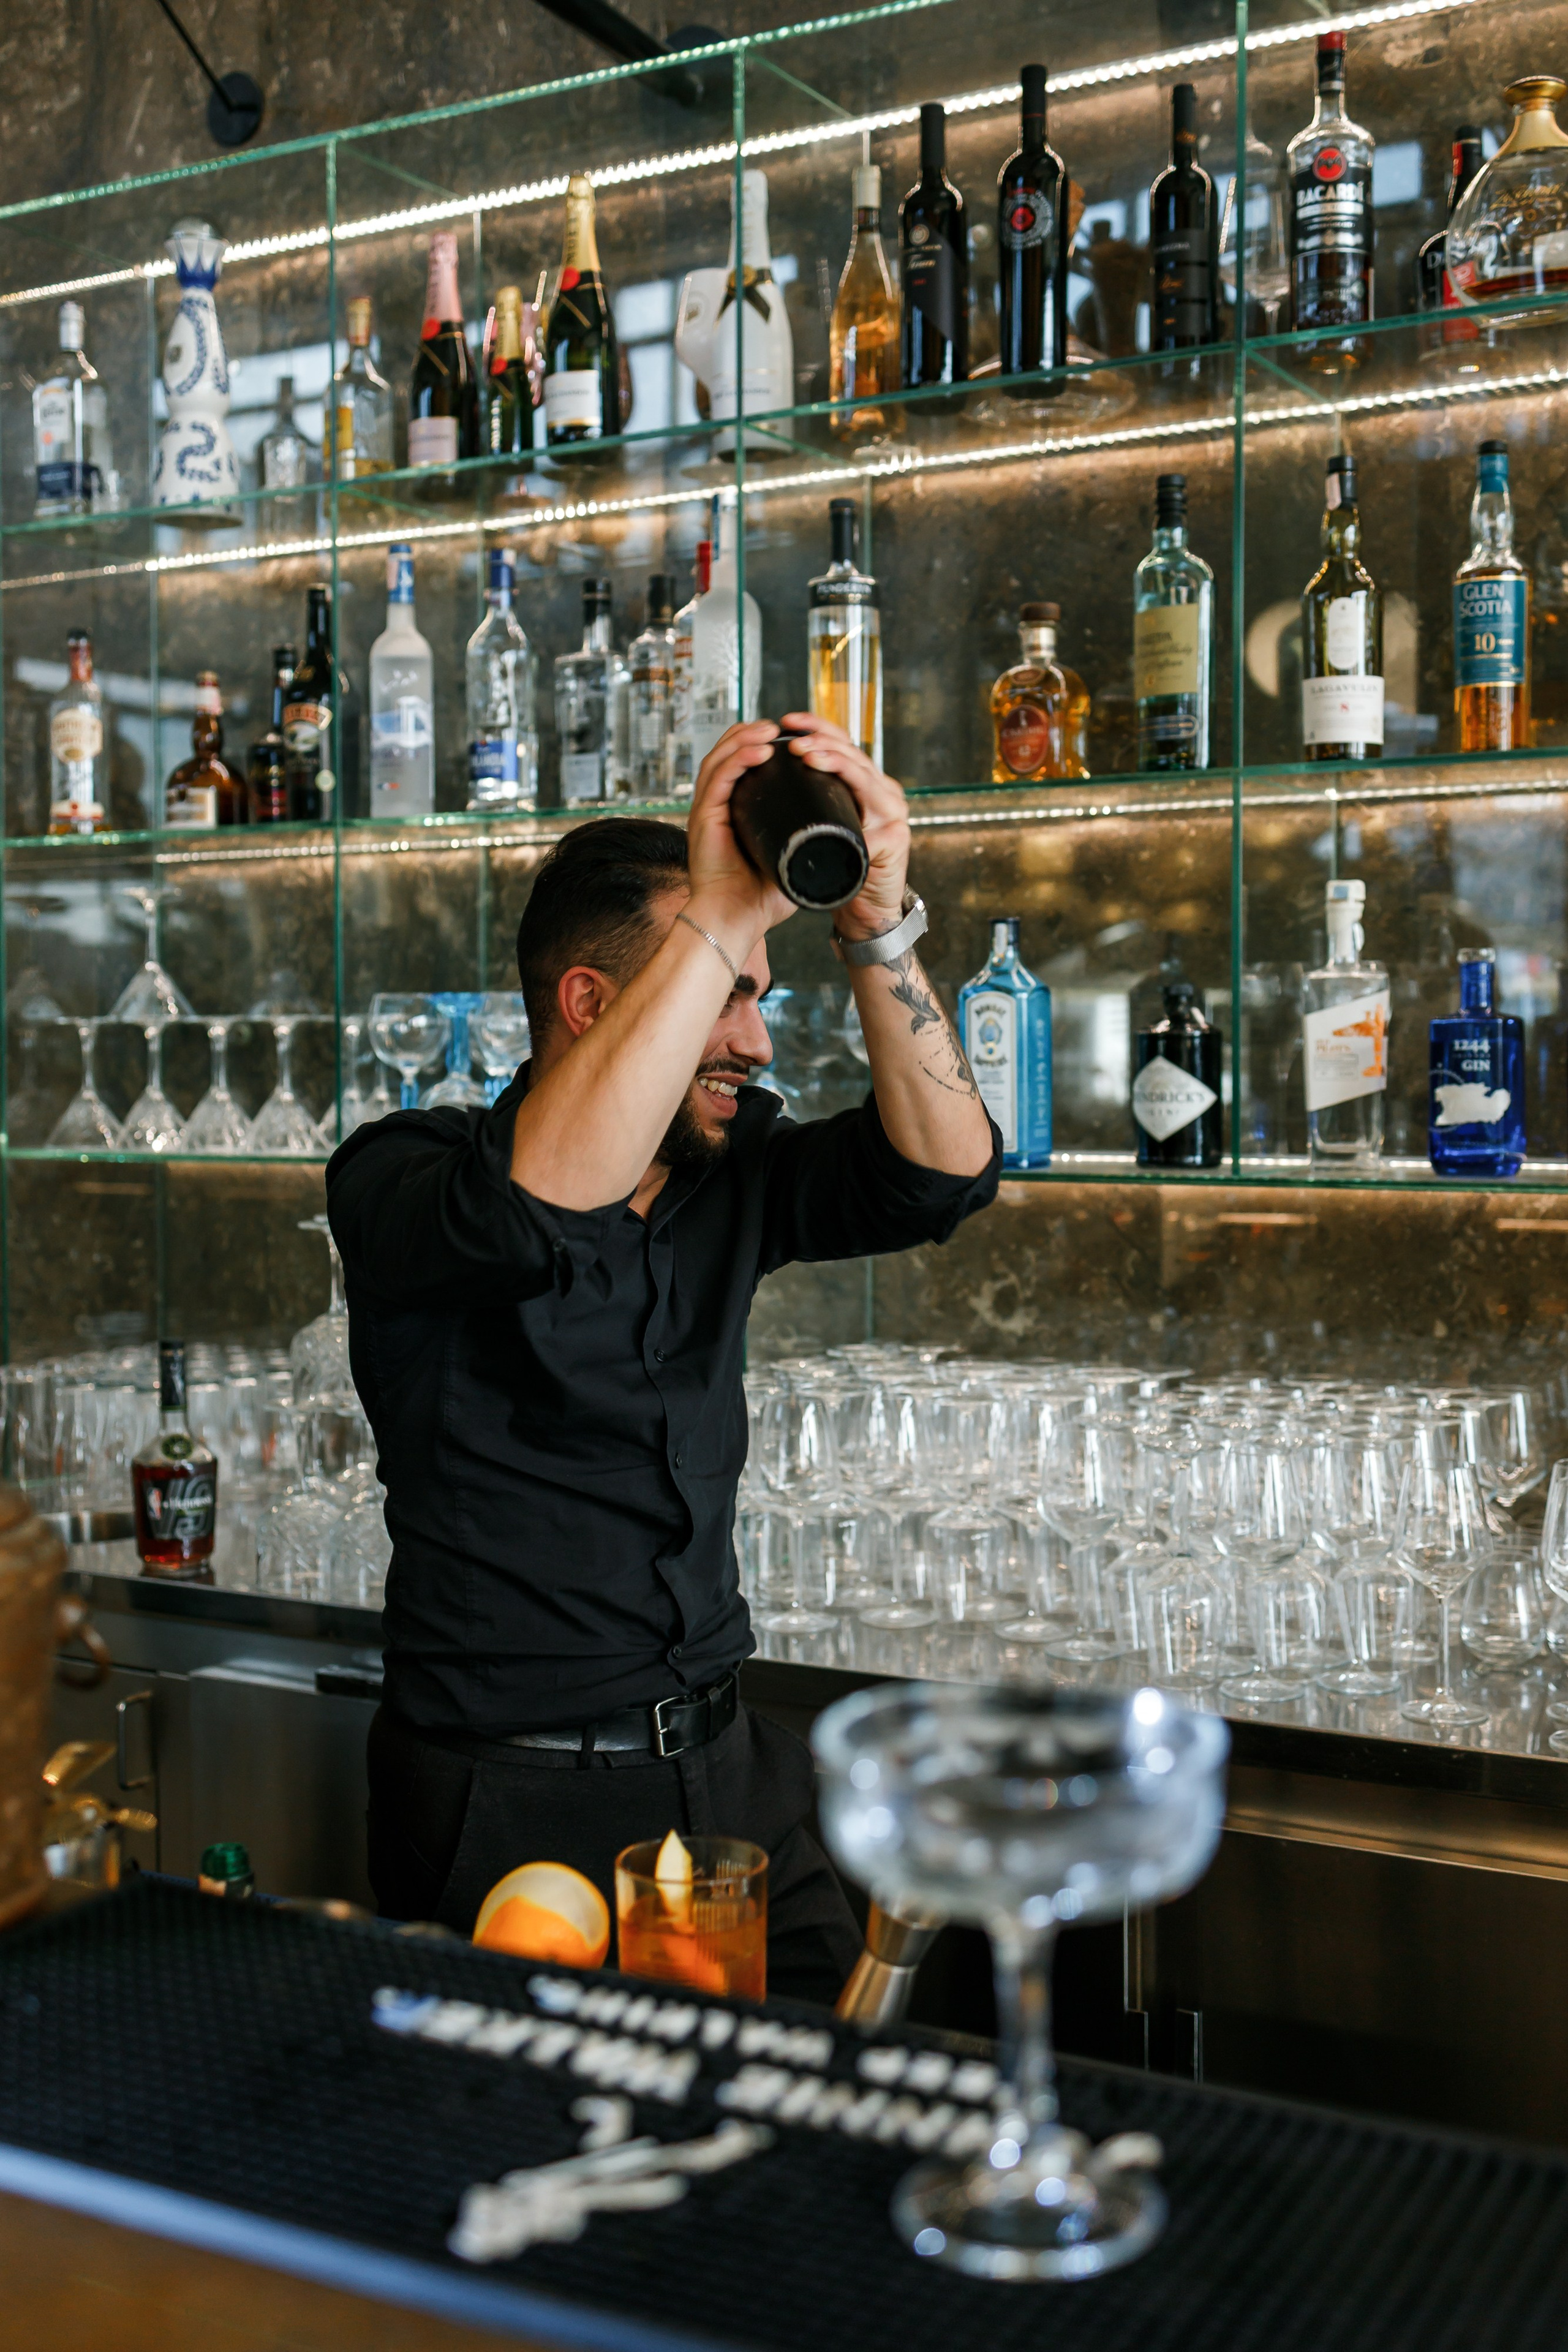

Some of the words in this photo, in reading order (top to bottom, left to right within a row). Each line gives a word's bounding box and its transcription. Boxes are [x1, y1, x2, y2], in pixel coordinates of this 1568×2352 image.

[1463, 583, 1504, 600] GLEN
[1459, 600, 1513, 617] SCOTIA
[1474, 631, 1496, 653] 10
[1453, 1039, 1491, 1054] 1244
[1461, 1060, 1491, 1071] GIN
